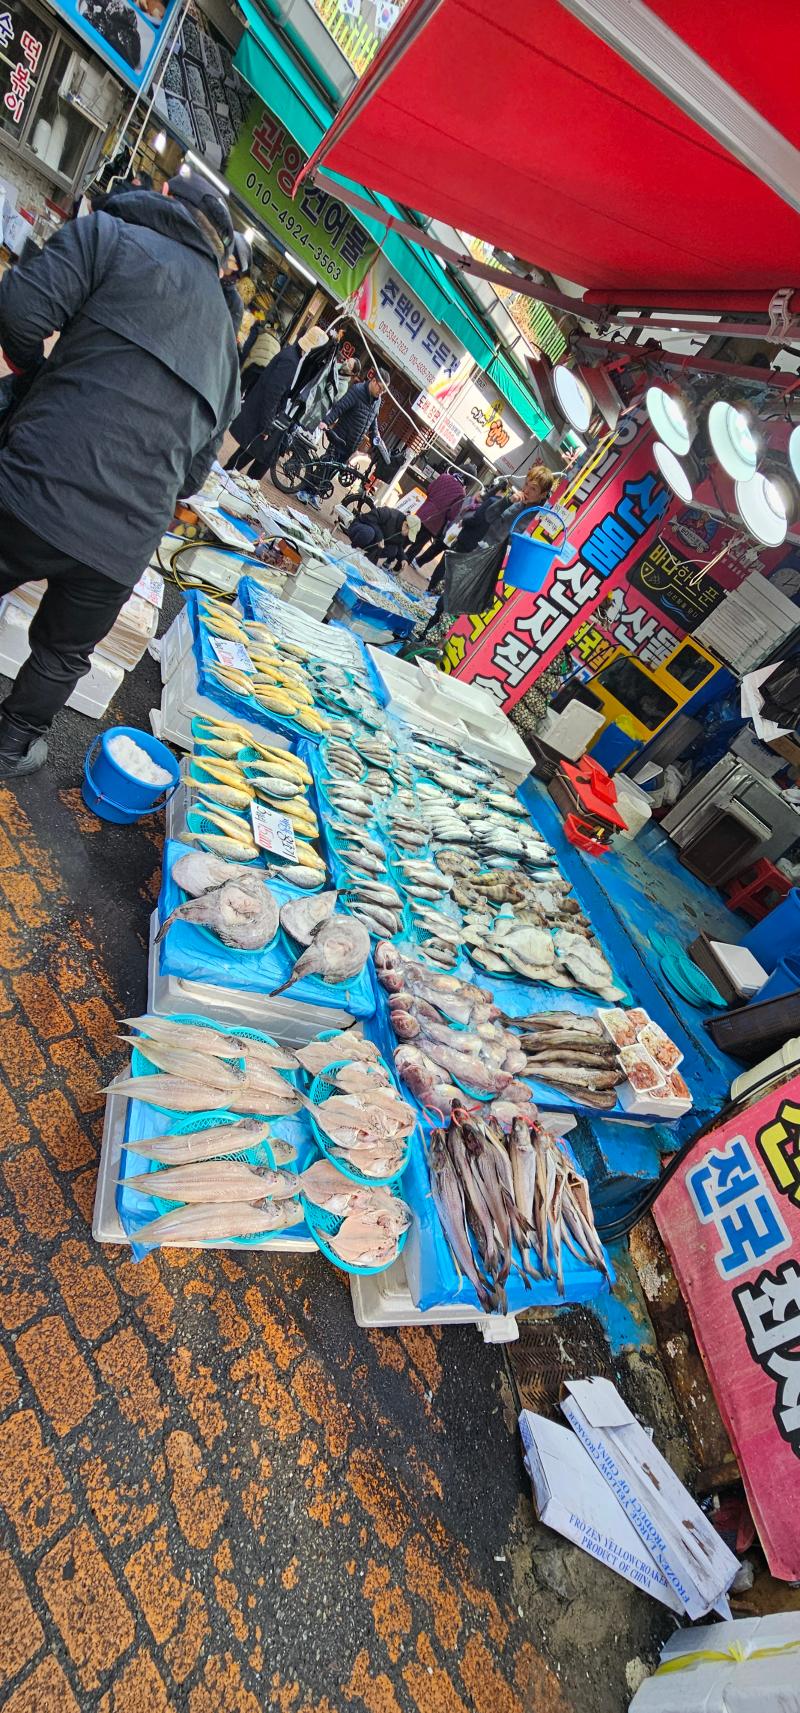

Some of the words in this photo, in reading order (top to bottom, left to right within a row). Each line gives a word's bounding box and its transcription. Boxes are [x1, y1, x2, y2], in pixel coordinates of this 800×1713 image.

[5, 30, 42, 124] 떡볶이
[245, 173, 342, 282] 010-4924-3563
[380, 278, 424, 339] 주택의
[651, 543, 720, 606] 바다한스푼
[688, 1138, 785, 1276] 전국
[568, 1411, 600, 1461] CROAKER
[597, 1441, 620, 1477] CHINA
[600, 1463, 631, 1510] YELLOW
[620, 1480, 632, 1496] OF
[568, 1514, 602, 1543] FROZEN
[630, 1496, 667, 1551] PRODUCT
[631, 1510, 659, 1550] LARGE
[580, 1536, 618, 1567] PRODUCT
[618, 1560, 630, 1573] OF
[629, 1567, 652, 1588] CHINA
[655, 1553, 690, 1604] FROZEN
